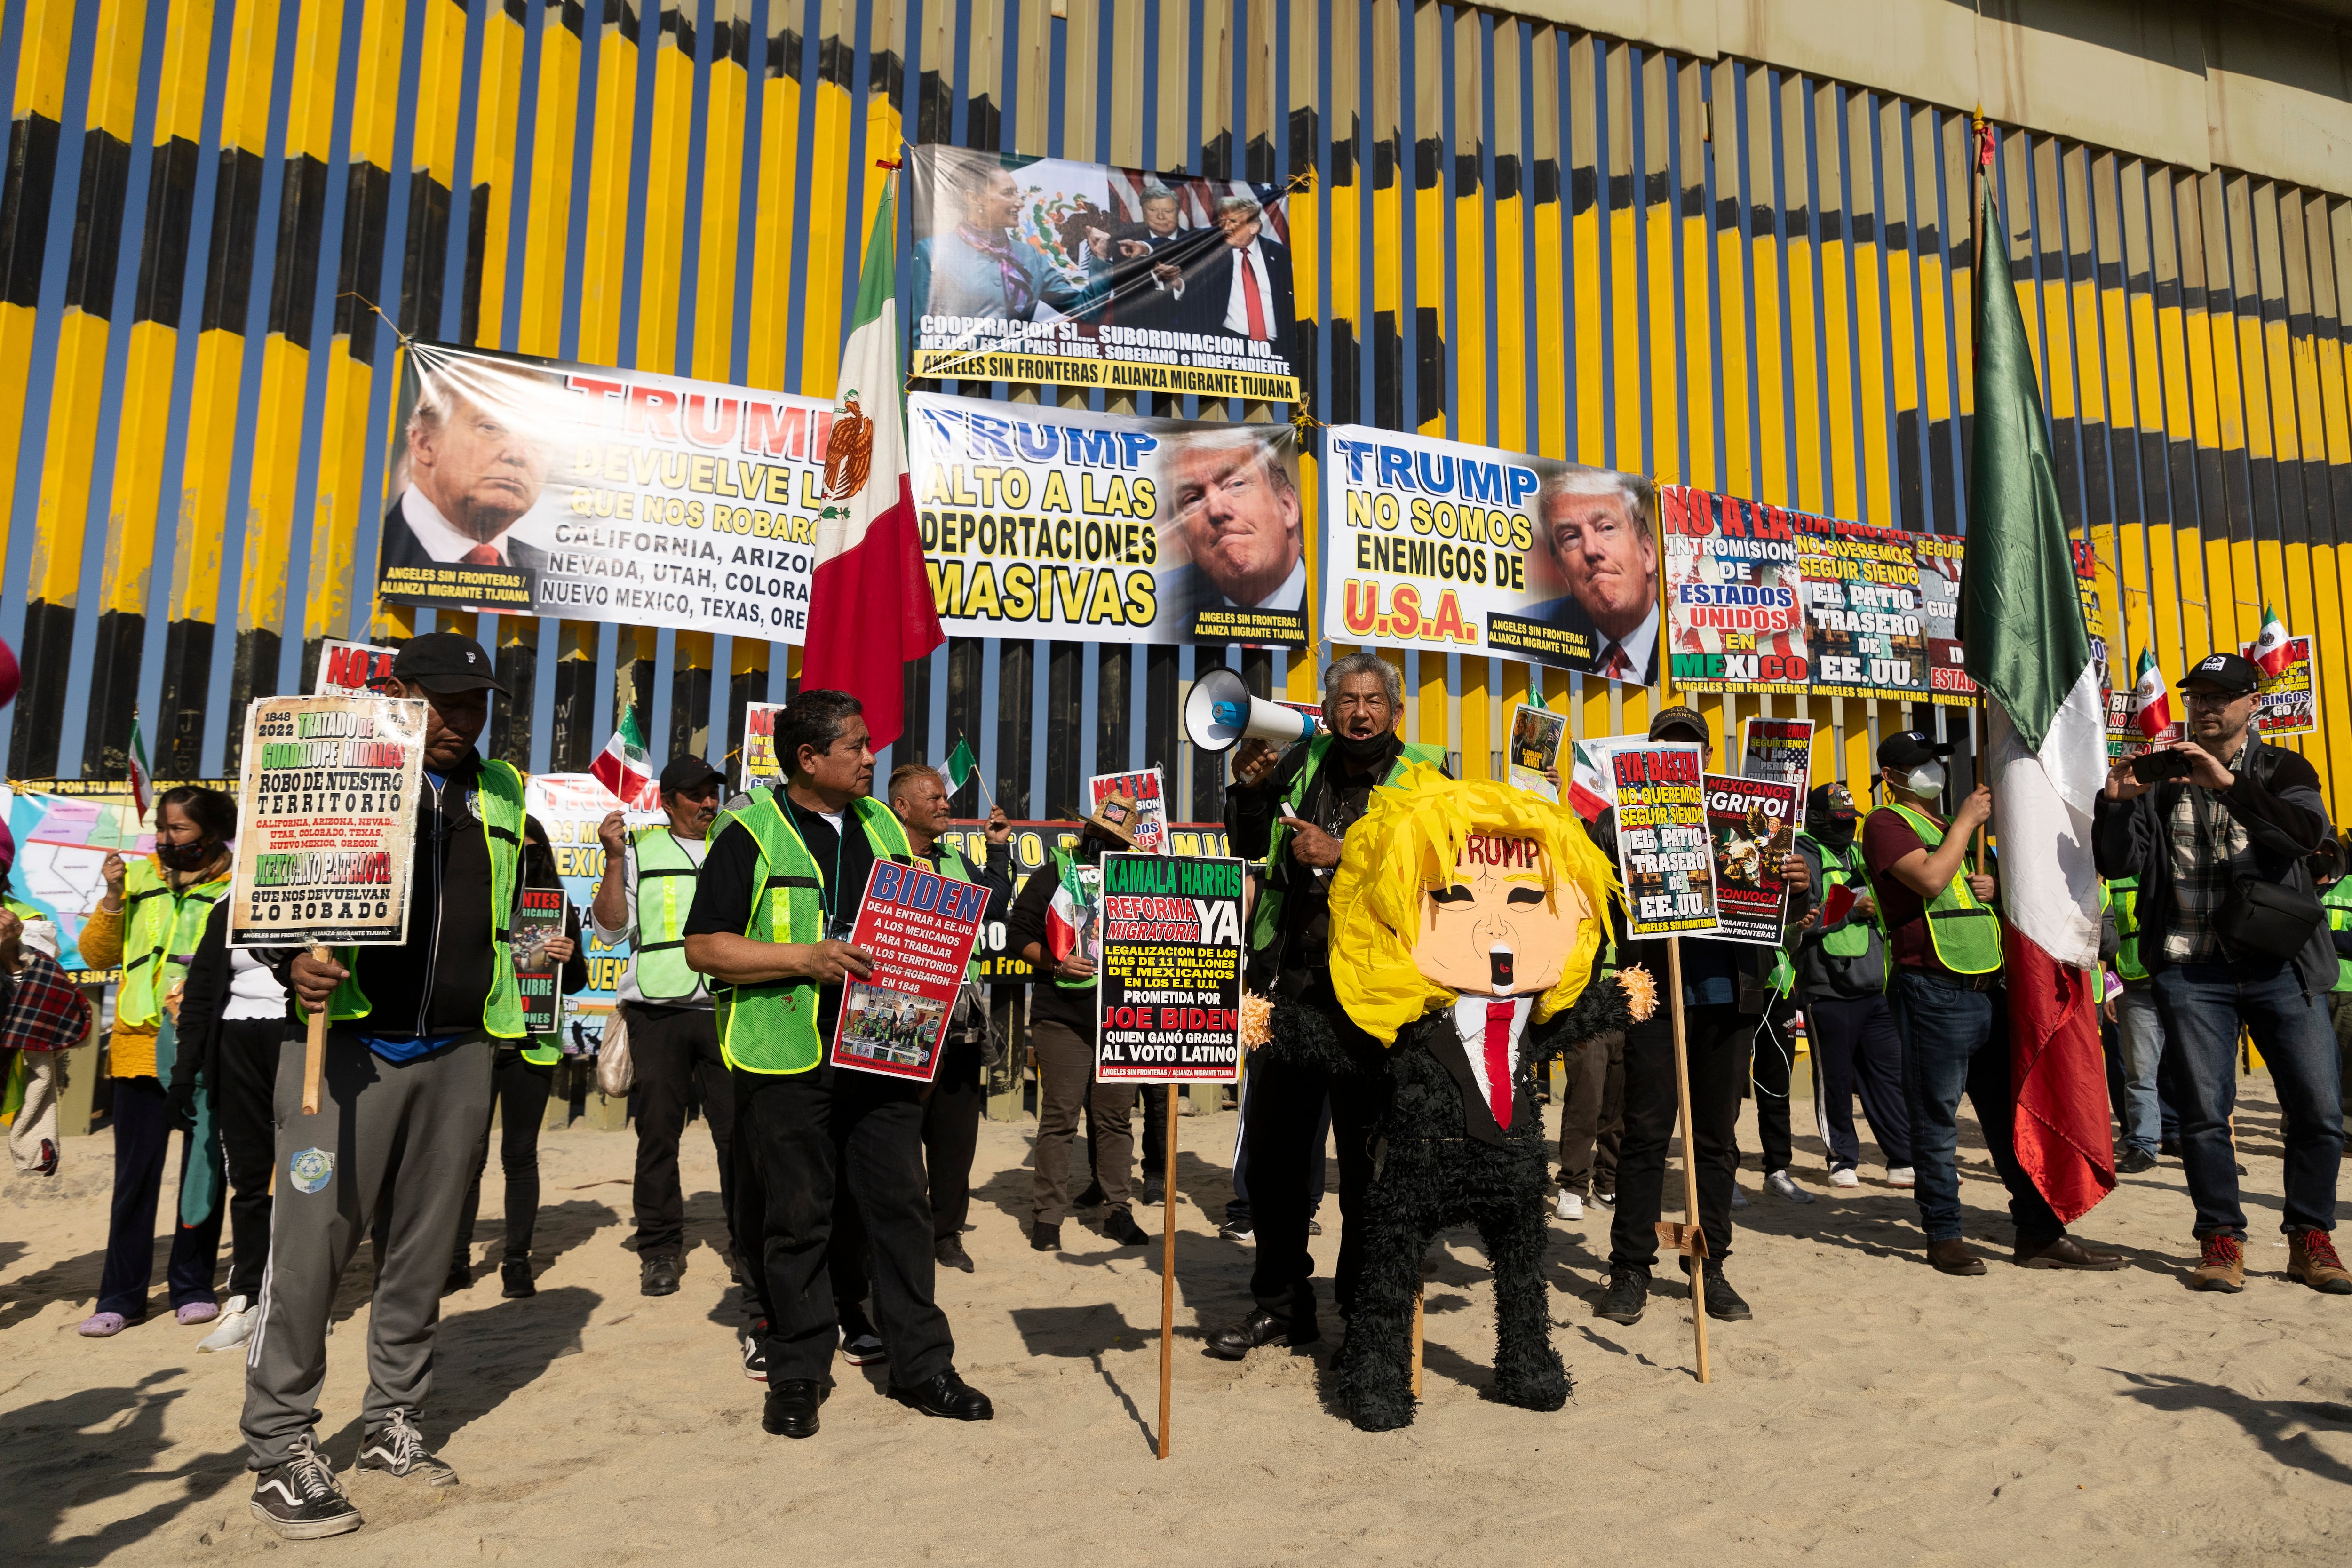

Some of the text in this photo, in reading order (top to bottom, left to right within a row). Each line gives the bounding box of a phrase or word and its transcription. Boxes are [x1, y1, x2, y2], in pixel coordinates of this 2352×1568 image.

[920, 315, 1055, 340] COOPERACION
[1098, 325, 1244, 356] SUBORDINACION
[1248, 339, 1283, 360] NO...
[920, 335, 1290, 375] MEXICO ES UN PAIS LIBRE, SOBERANO e INDEPENDIENTE
[923, 355, 1293, 399] ANGELES SIN FRONTERAS ALIANZA MIGRANTE TIJUANA
[918, 408, 1160, 470] TRUMP
[574, 441, 790, 505] DEVUELVE
[1334, 439, 1540, 509] TRUMP
[921, 463, 1156, 520] ALTO A LAS
[572, 486, 704, 528] QUE NOS
[1662, 486, 1714, 535] NO
[1721, 494, 1746, 538] A
[1748, 501, 1793, 540] LA
[1346, 489, 1533, 551] NO SOMOS
[556, 525, 722, 565] CALIFORNIA,
[921, 510, 1158, 565] DEPORTACIONES
[1669, 537, 1794, 561] INTROMISION
[549, 553, 717, 592] NEVADA, UTAH,
[1357, 533, 1525, 593] ENEMIGOS DE
[1718, 561, 1752, 580] DE
[542, 581, 764, 627] NUEVO MEXICO, TEXAS,
[924, 559, 1157, 628] MASIVAS
[1679, 583, 1793, 608] ESTADOS
[1199, 612, 1296, 627] ANGELES SIN FRONTERAS
[1343, 579, 1478, 645] U.S.A.
[1689, 607, 1788, 632] UNIDOS
[1195, 624, 1305, 640] ALIANZA MIGRANTE TIJUANA
[1725, 633, 1756, 650] EN
[327, 646, 369, 688] NO
[466, 652, 476, 663] P
[1673, 653, 1808, 680] MEXICO
[265, 712, 291, 722] 1848
[2109, 712, 2127, 727] NO
[2259, 715, 2304, 729] HOME
[2273, 705, 2291, 716] GO
[259, 724, 294, 736] 2022
[298, 711, 373, 739] TRATADO DE
[262, 741, 405, 771] GUADALUPE HIDALGO
[1524, 755, 1539, 769] GRINGO
[1614, 751, 1700, 786] ¡YA BASTA!
[56, 780, 106, 794] PON TU
[259, 772, 403, 793] ROBO DE NUESTRO
[1136, 773, 1159, 799] LA
[1708, 778, 1791, 799] MEXICANOS
[258, 793, 401, 814] TERRITORIO
[1617, 786, 1702, 805] NO QUEREMOS
[256, 818, 356, 828] CALIFORNIA, ARIZONA,
[1620, 806, 1704, 827] SEGUIR SIENDO
[1718, 812, 1746, 820] GUERRA
[299, 828, 383, 838] COLORADO, TEXAS,
[1629, 828, 1702, 850] EL PATIO
[270, 840, 337, 850] NUEVO MEXICO,
[254, 852, 391, 887] MEXICANO PATRIOTA
[1631, 851, 1706, 874] TRASERO
[1106, 859, 1241, 897] KAMALA HARRIS
[1668, 876, 1682, 890] DE
[251, 888, 391, 902] QUE NOS DEVUELVAN
[870, 862, 985, 923] BIDEN
[250, 902, 387, 921] LO ROBADO
[1639, 892, 1709, 919] EE.UU.
[866, 901, 974, 936] DEJA ENTRAR A EE.UU.
[1105, 895, 1240, 945] REFORMA YA
[874, 918, 960, 947] A LOS MEXICANOS
[1106, 921, 1199, 942] MIGRATORIA
[1732, 929, 1775, 939] FRONTERAS
[875, 932, 952, 959] PARA TRABAJAR
[1105, 946, 1238, 958] LEGALIZACION DE LOS
[875, 947, 958, 974] LOS TERRITORIOS
[1107, 956, 1235, 969] MAS DE 11 MILLONES
[882, 963, 950, 987] NOS ROBARON
[1108, 967, 1235, 979] DE MEXICANOS
[1124, 978, 1219, 989] EN LOS E.E. U.U.
[521, 979, 553, 995] LIBRE
[882, 977, 920, 994] EN 1848
[1124, 990, 1221, 1005] PROMETIDA POR
[1102, 1006, 1238, 1030] JOE BIDEN
[1106, 1029, 1233, 1044] QUIEN GANÓ GRACIAS
[1101, 1044, 1237, 1062] AL VOTO LATINO
